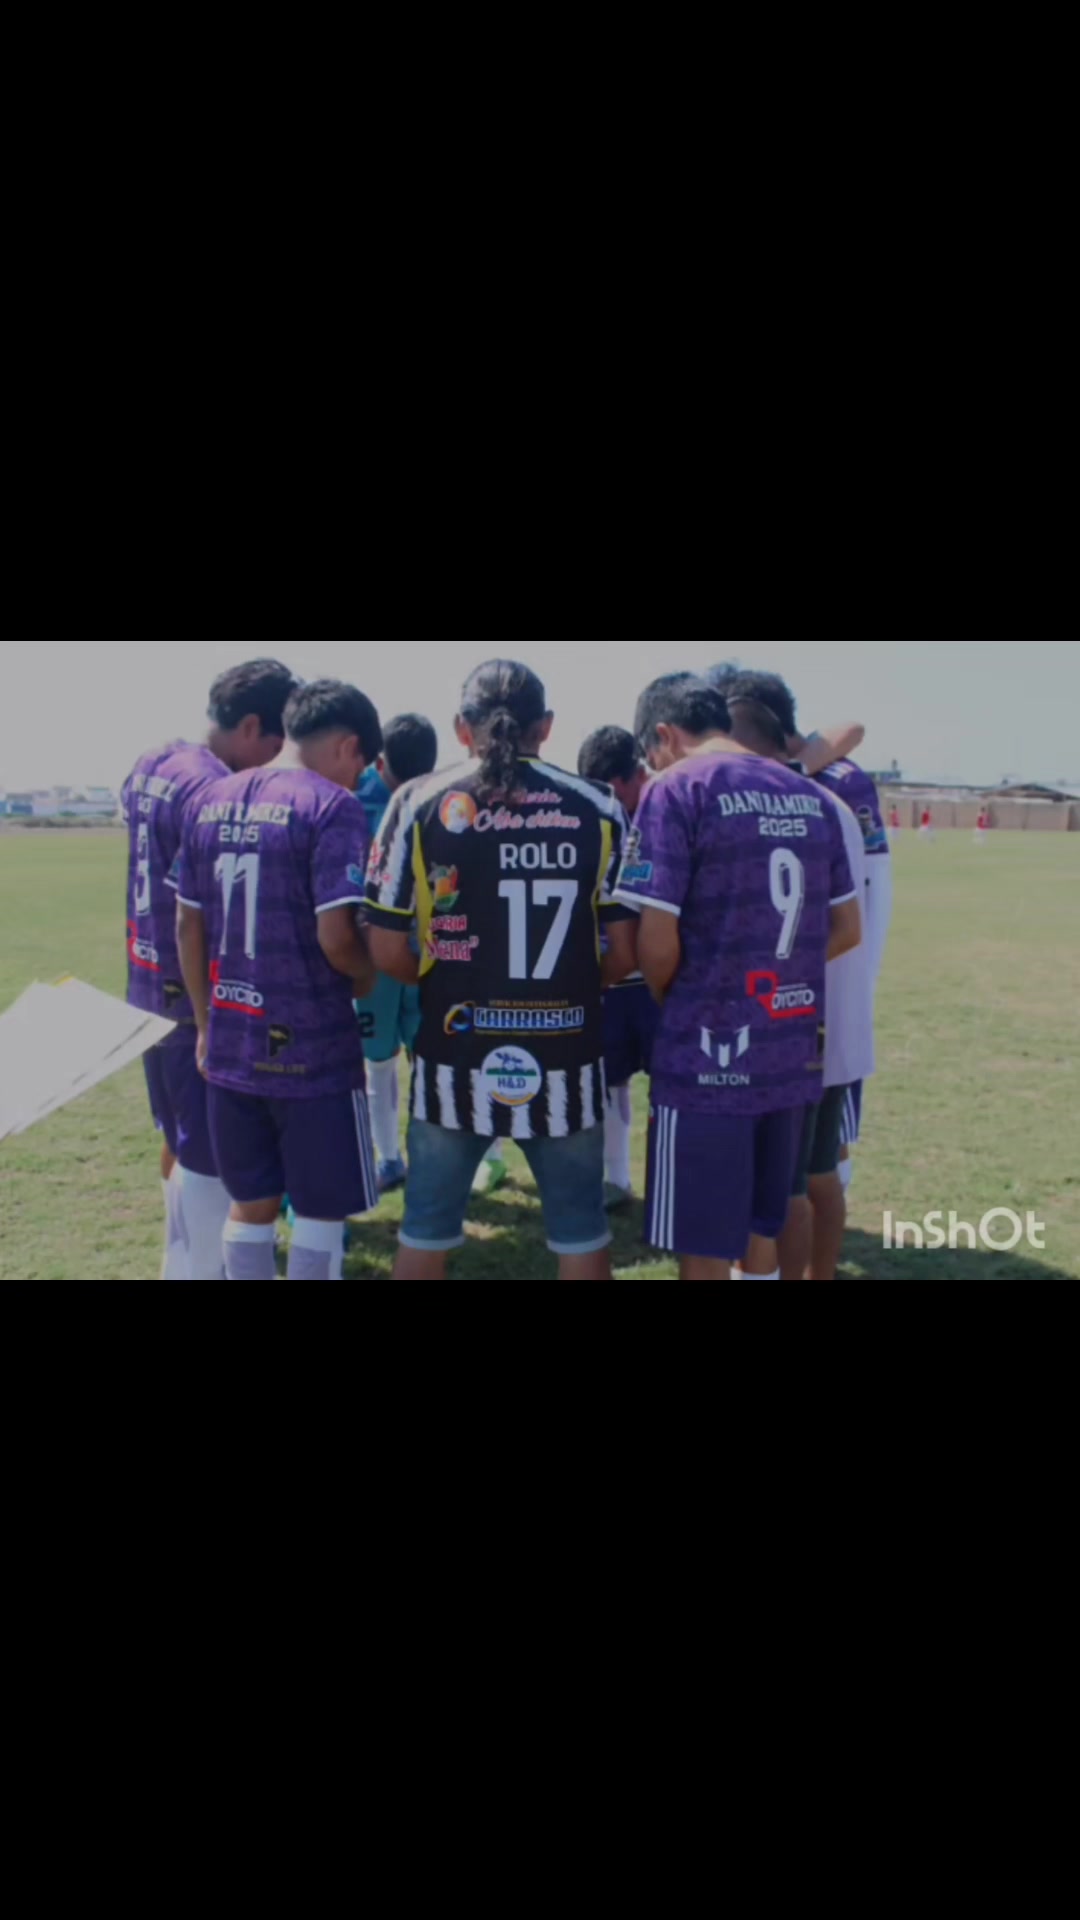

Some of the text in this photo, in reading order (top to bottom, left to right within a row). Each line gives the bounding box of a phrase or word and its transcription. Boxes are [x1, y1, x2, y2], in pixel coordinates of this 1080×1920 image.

[219, 824, 260, 844] 205
[758, 816, 808, 837] 2025
[499, 842, 577, 870] ROLO
[214, 853, 260, 959] 11
[769, 847, 805, 960] 9
[498, 879, 579, 980] 17
[474, 1005, 585, 1029] CARRASCO
[496, 1076, 528, 1090] H&D
[698, 1073, 750, 1086] MILTON
